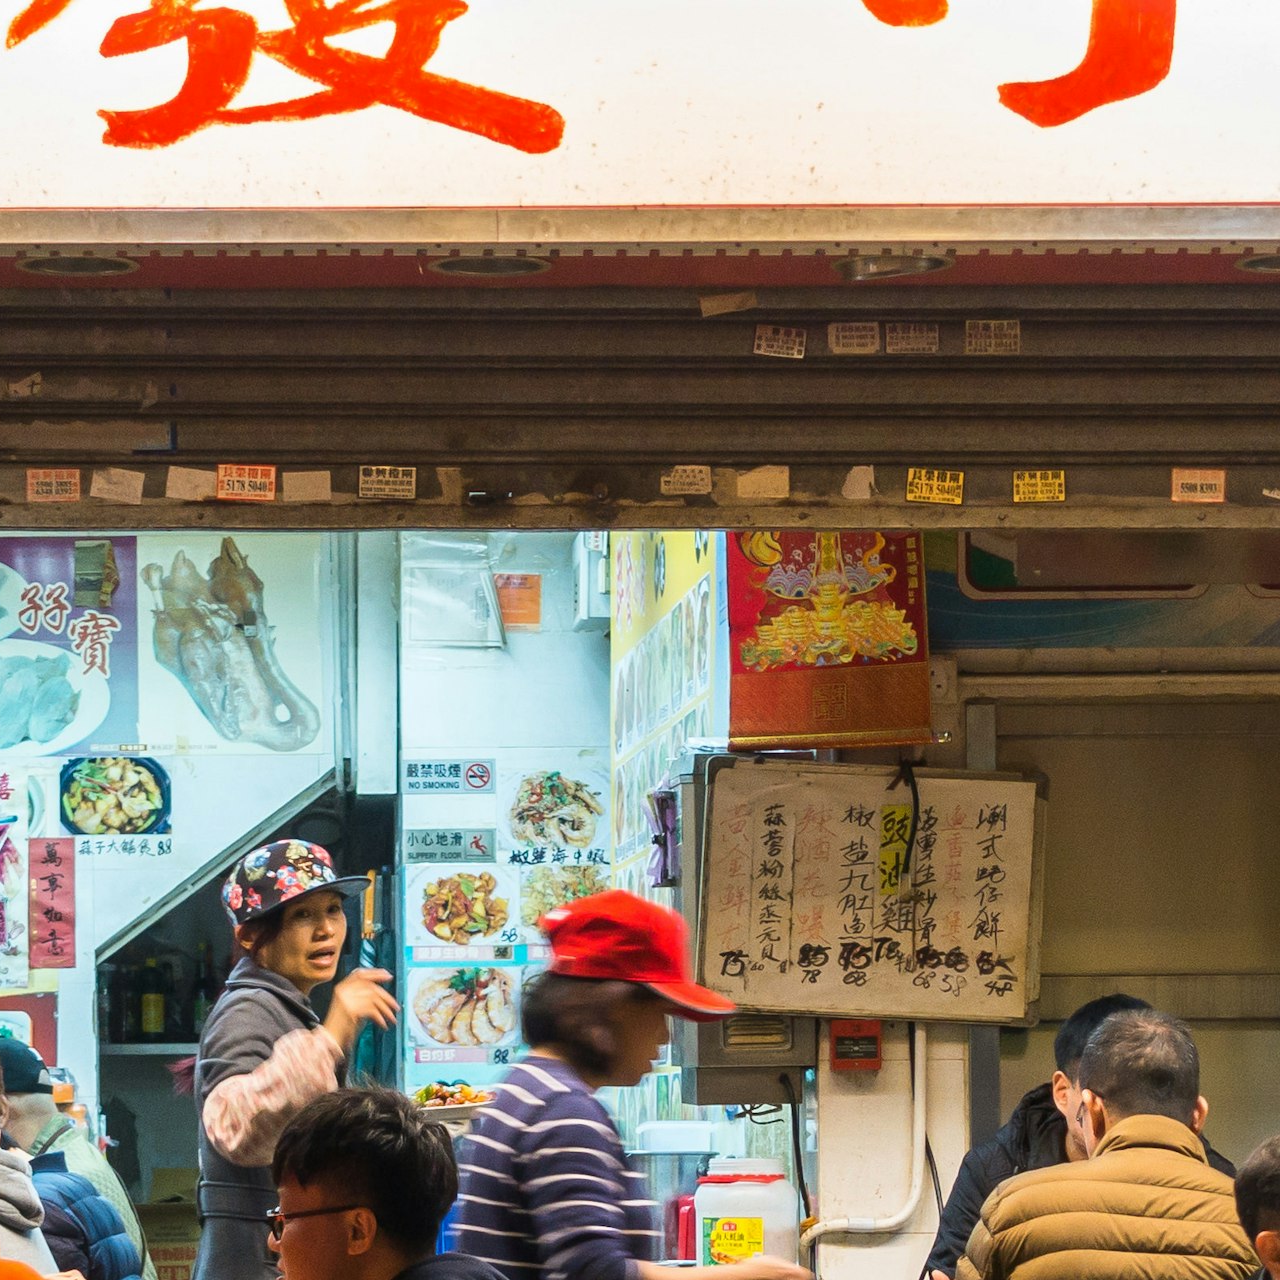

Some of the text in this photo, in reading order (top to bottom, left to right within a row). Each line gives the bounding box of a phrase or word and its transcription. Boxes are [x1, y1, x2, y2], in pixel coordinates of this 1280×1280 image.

[226, 480, 246, 491] 5178
[406, 763, 462, 779] 嚴禁吸煙
[408, 781, 460, 790] NO SMOKING
[157, 838, 172, 855] 88
[407, 832, 463, 847] 小心地滑
[407, 851, 462, 859] SLIPPERY FLOOR
[501, 928, 518, 942] 58
[493, 1048, 510, 1065] 88
